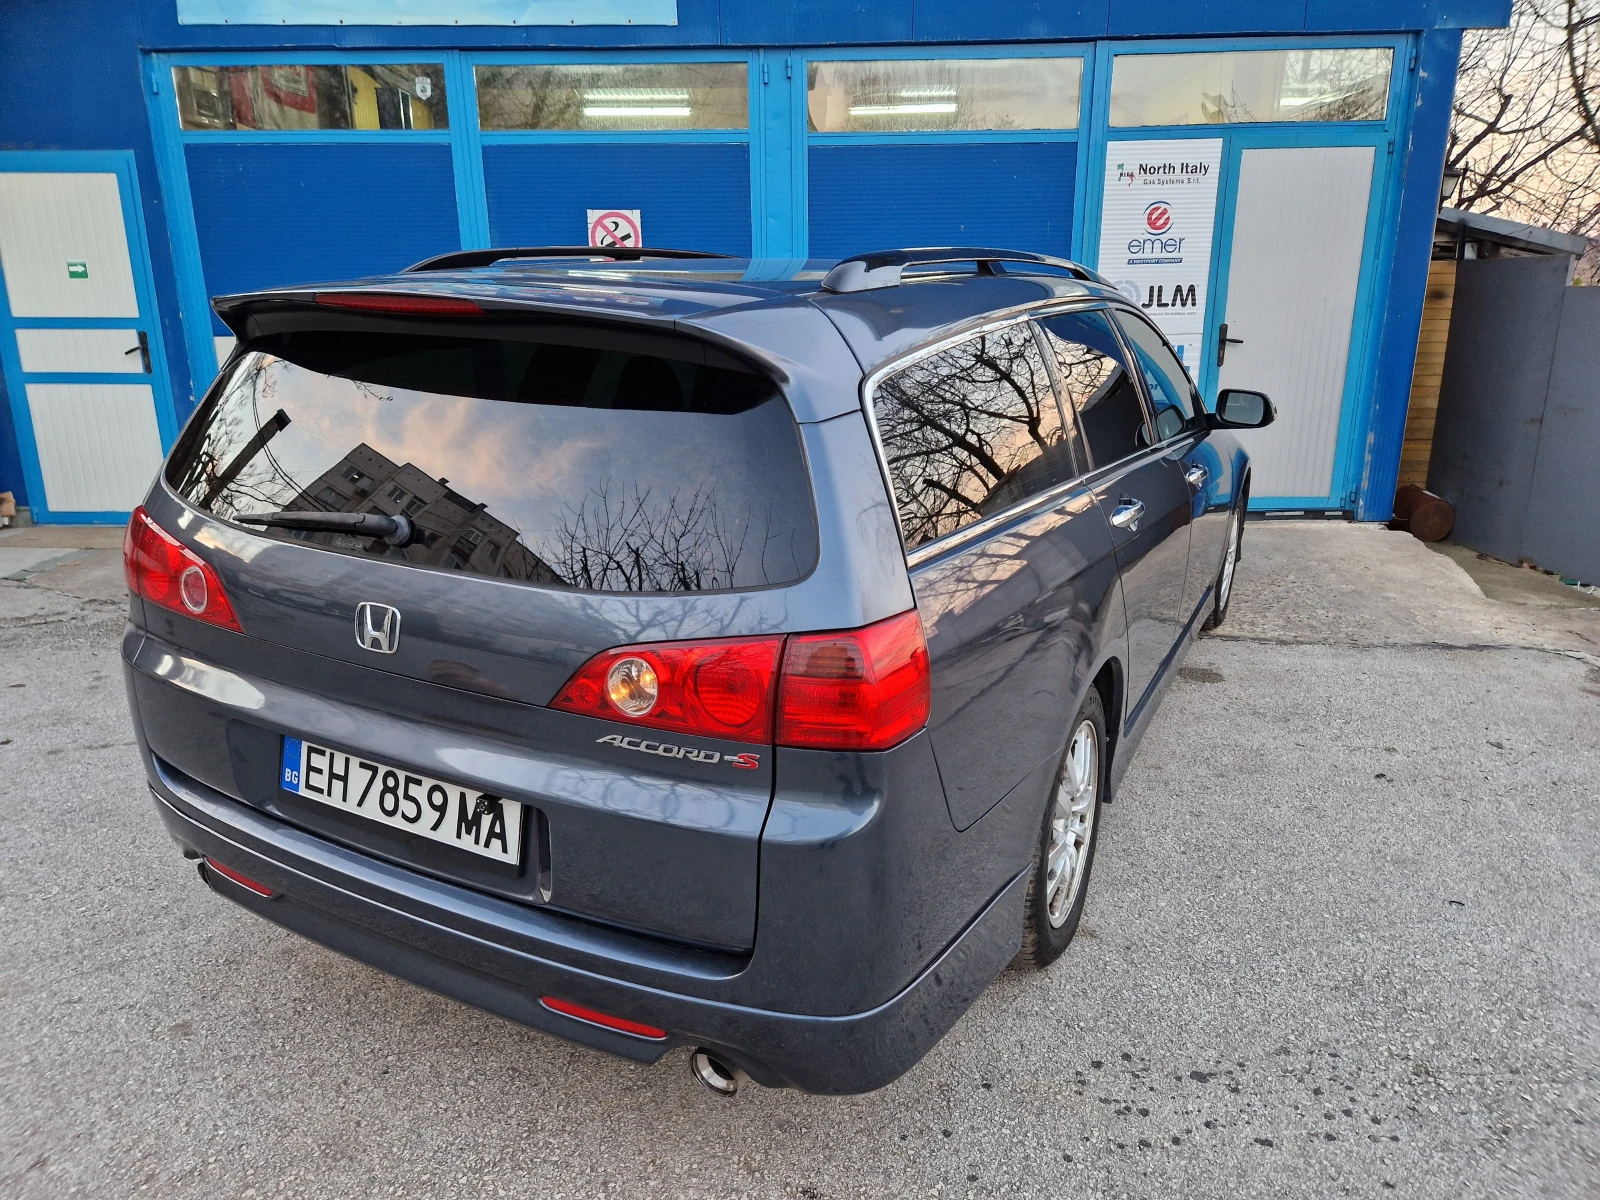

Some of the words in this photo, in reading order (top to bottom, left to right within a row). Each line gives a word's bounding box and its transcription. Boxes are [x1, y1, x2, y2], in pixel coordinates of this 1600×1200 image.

[1138, 163, 1176, 175] North
[1180, 162, 1210, 176] Italy
[1143, 178, 1156, 186] Gas
[1157, 177, 1185, 186] Systems
[1128, 237, 1186, 254] emer
[1141, 284, 1197, 309] JLM
[595, 734, 721, 764] ACCORD
[284, 767, 299, 785] BG
[304, 744, 350, 803] EH
[355, 761, 449, 832] 7859
[455, 791, 509, 855] MA
